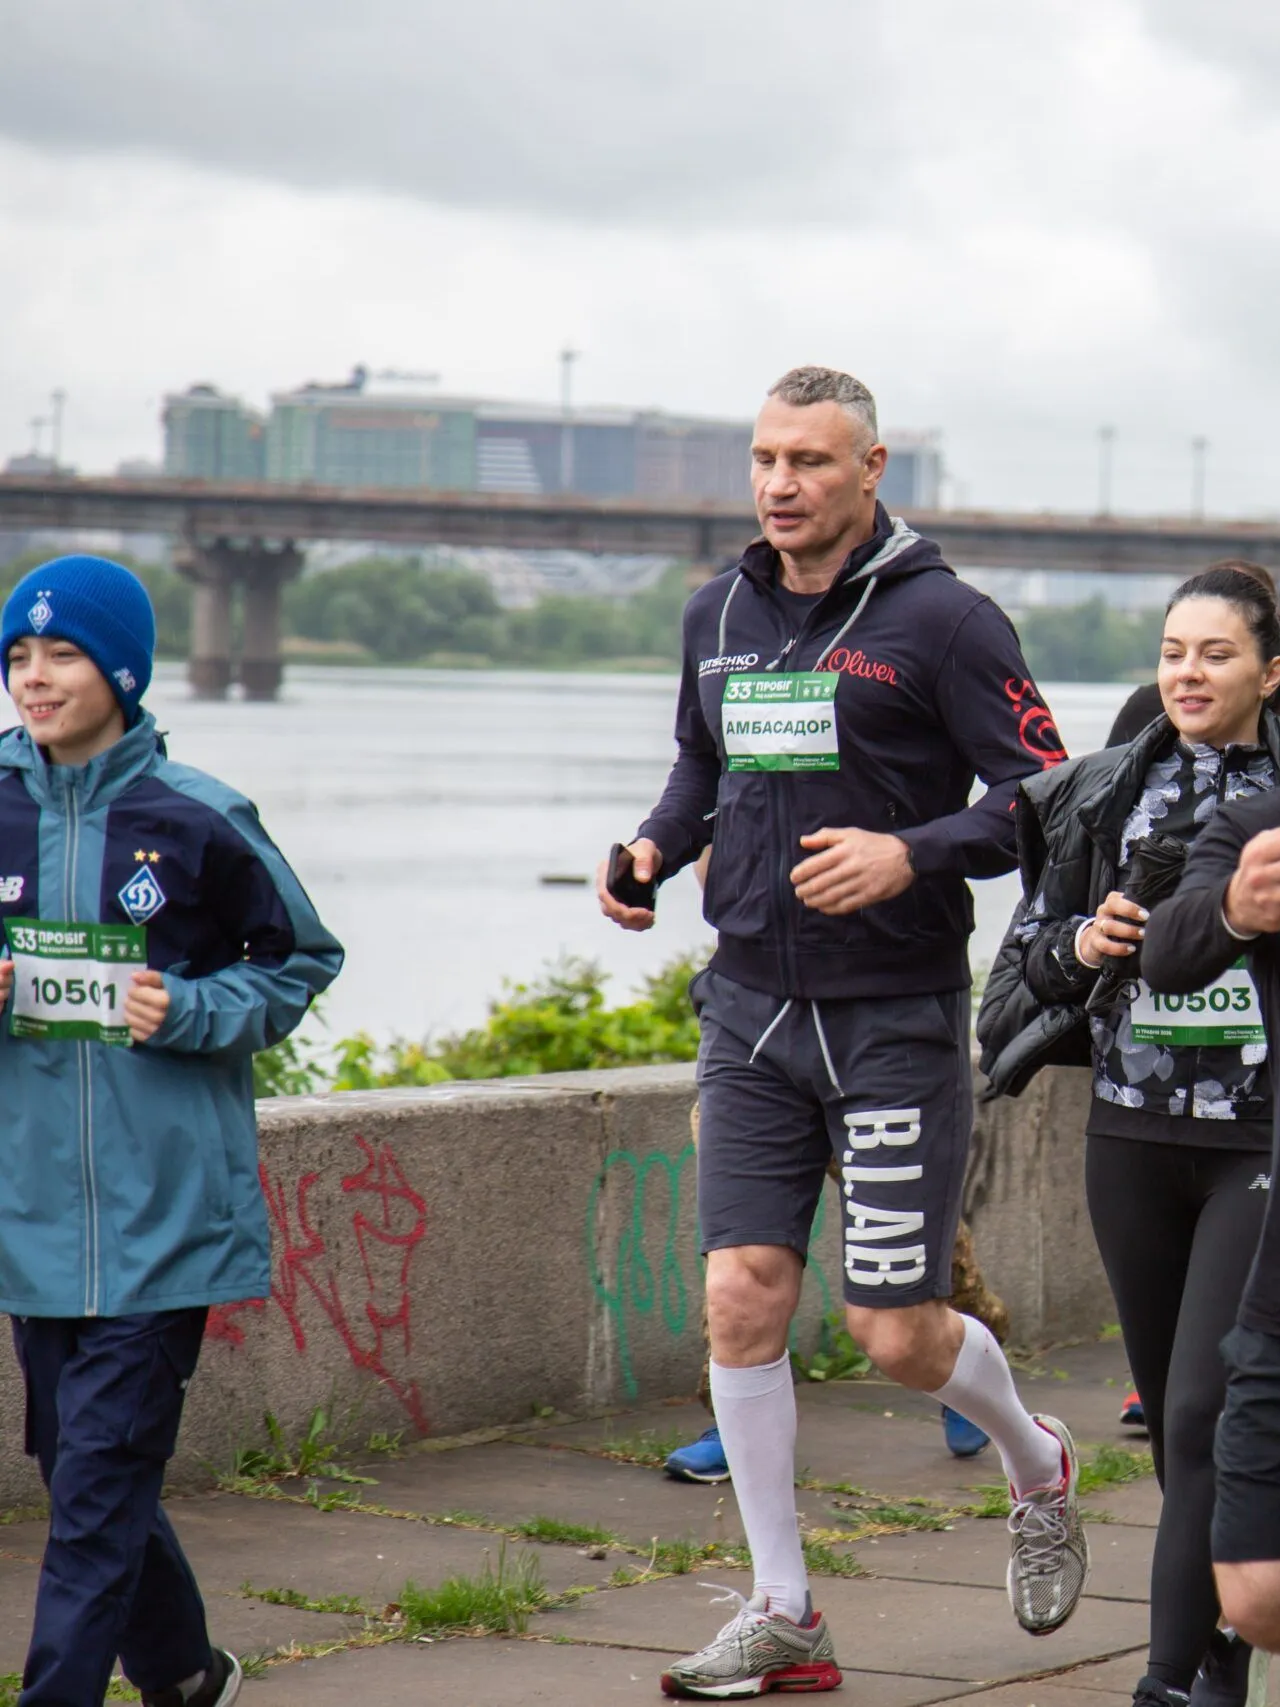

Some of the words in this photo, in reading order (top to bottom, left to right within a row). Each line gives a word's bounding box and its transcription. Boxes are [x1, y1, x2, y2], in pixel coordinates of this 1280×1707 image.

[755, 680, 793, 692] ПРОБІГ
[726, 719, 832, 736] АМБАСАДОР
[38, 930, 88, 945] ПРОБІГ
[31, 976, 116, 1010] 10501
[1149, 987, 1252, 1013] 10503
